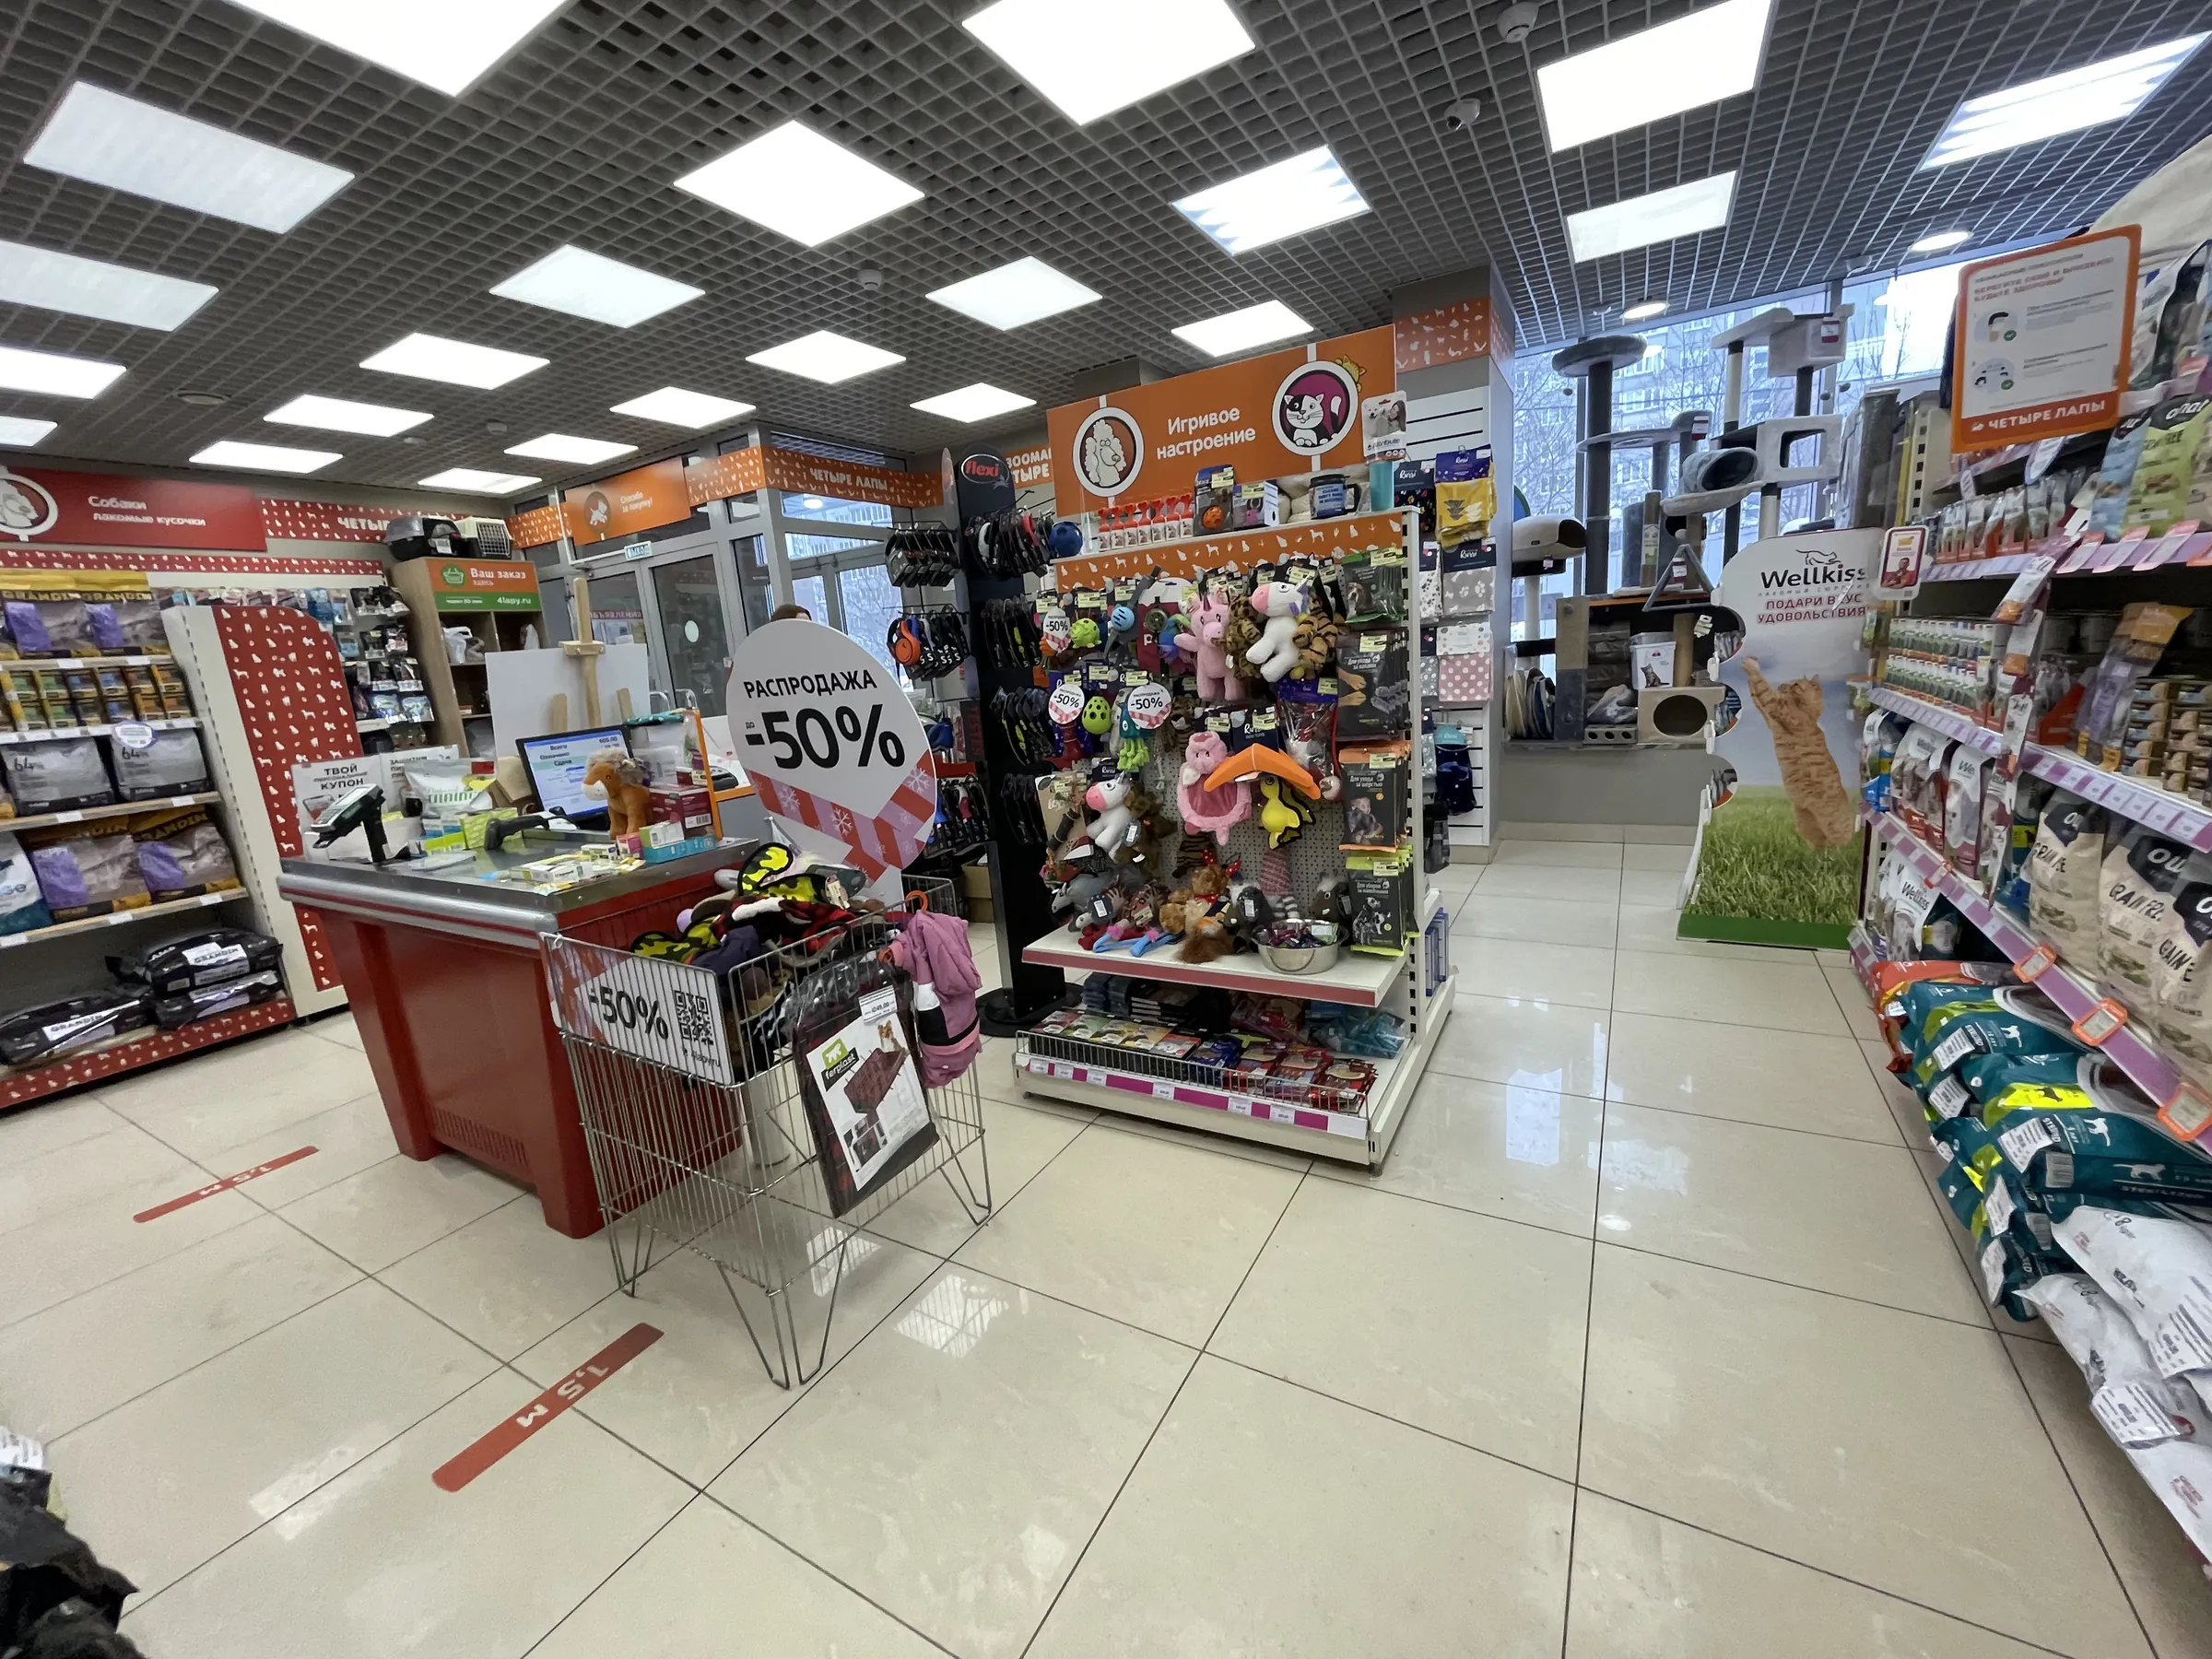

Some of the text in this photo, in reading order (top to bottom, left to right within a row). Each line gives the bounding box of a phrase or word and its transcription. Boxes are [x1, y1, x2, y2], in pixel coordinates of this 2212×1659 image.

[1167, 407, 1241, 436] Игривое
[1988, 400, 2106, 429] ЧЕТЫРЕ ЛАПЫ
[1157, 427, 1256, 460] настроение
[964, 459, 1000, 477] flexi
[1012, 463, 1050, 484] ТЫРЕ
[809, 467, 888, 491] ЧЕТЫРЕ ЛАПЫ
[88, 495, 147, 511] Собаки
[470, 567, 527, 580] Ваш заказ
[1760, 564, 1867, 590] Wellkiss
[497, 596, 532, 606] 4lapy.ru
[1766, 593, 1863, 610] ПОДАРИ ВУС
[1045, 620, 1069, 632] -50%
[743, 669, 877, 699] РАСПРОДАЖА
[1053, 693, 1080, 709] -50%
[1130, 696, 1164, 711] -50%
[745, 703, 905, 770] -50%
[324, 763, 359, 776] ТВОЙ
[320, 777, 365, 791] КУПОН
[588, 985, 669, 1040] -50%
[49, 1015, 103, 1032] GRANDIN
[825, 1053, 856, 1080] ferplast
[557, 1365, 609, 1401] 1,5
